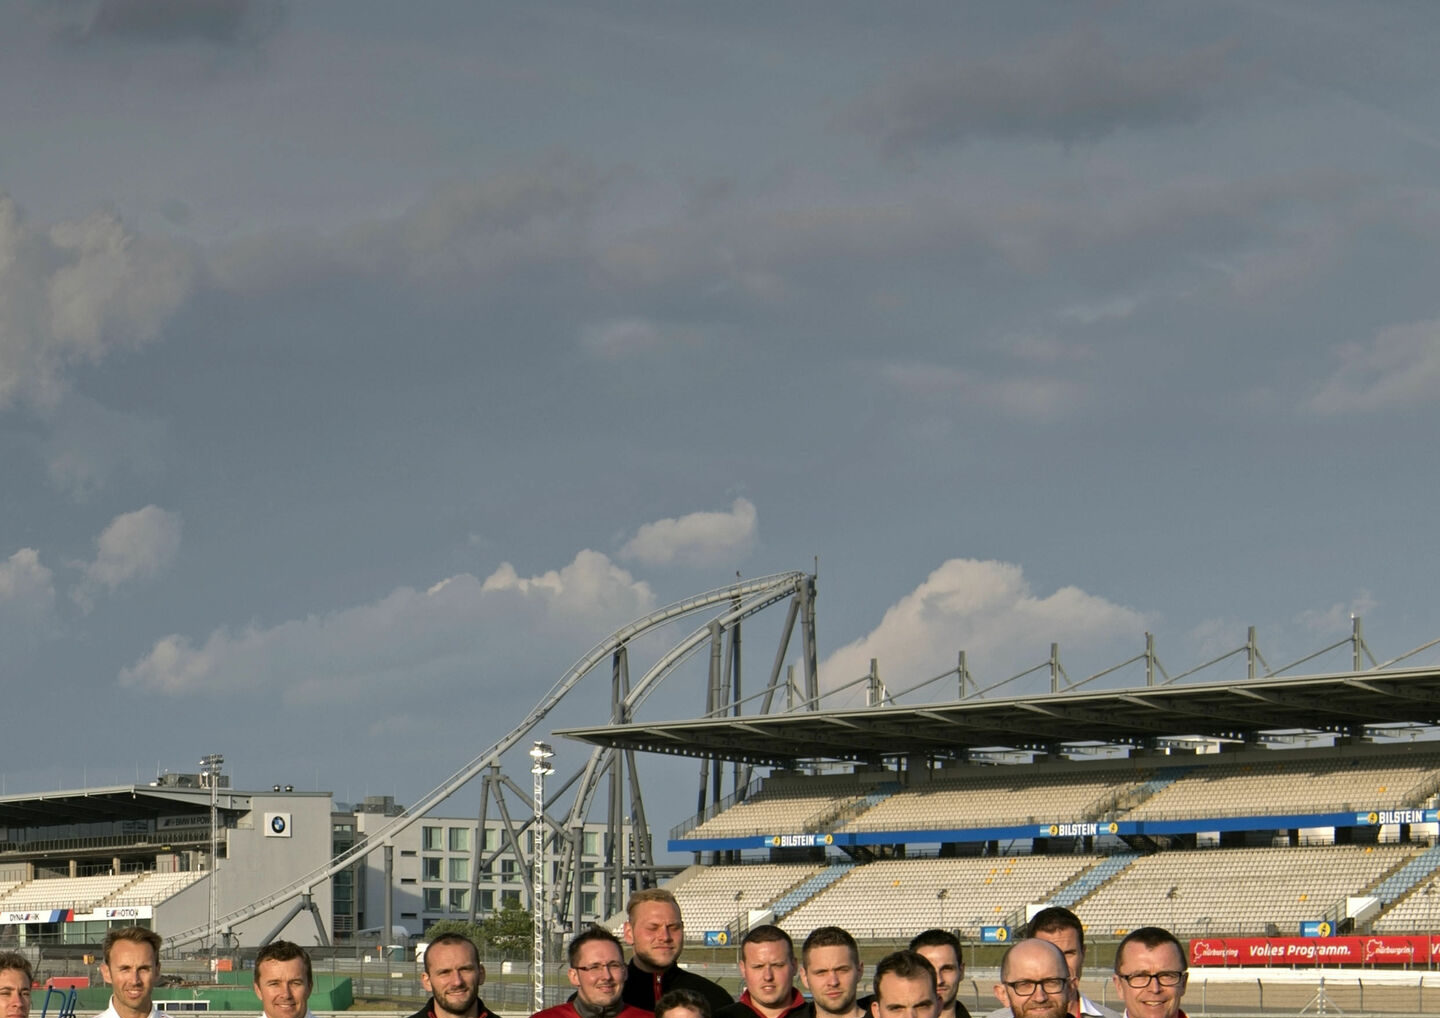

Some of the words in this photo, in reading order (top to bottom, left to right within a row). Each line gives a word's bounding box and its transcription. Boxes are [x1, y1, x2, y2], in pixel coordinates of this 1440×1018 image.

[1379, 810, 1423, 824] BILSTEIN
[1059, 823, 1097, 836] BILSTEIN
[781, 834, 815, 847] BILSTEIN
